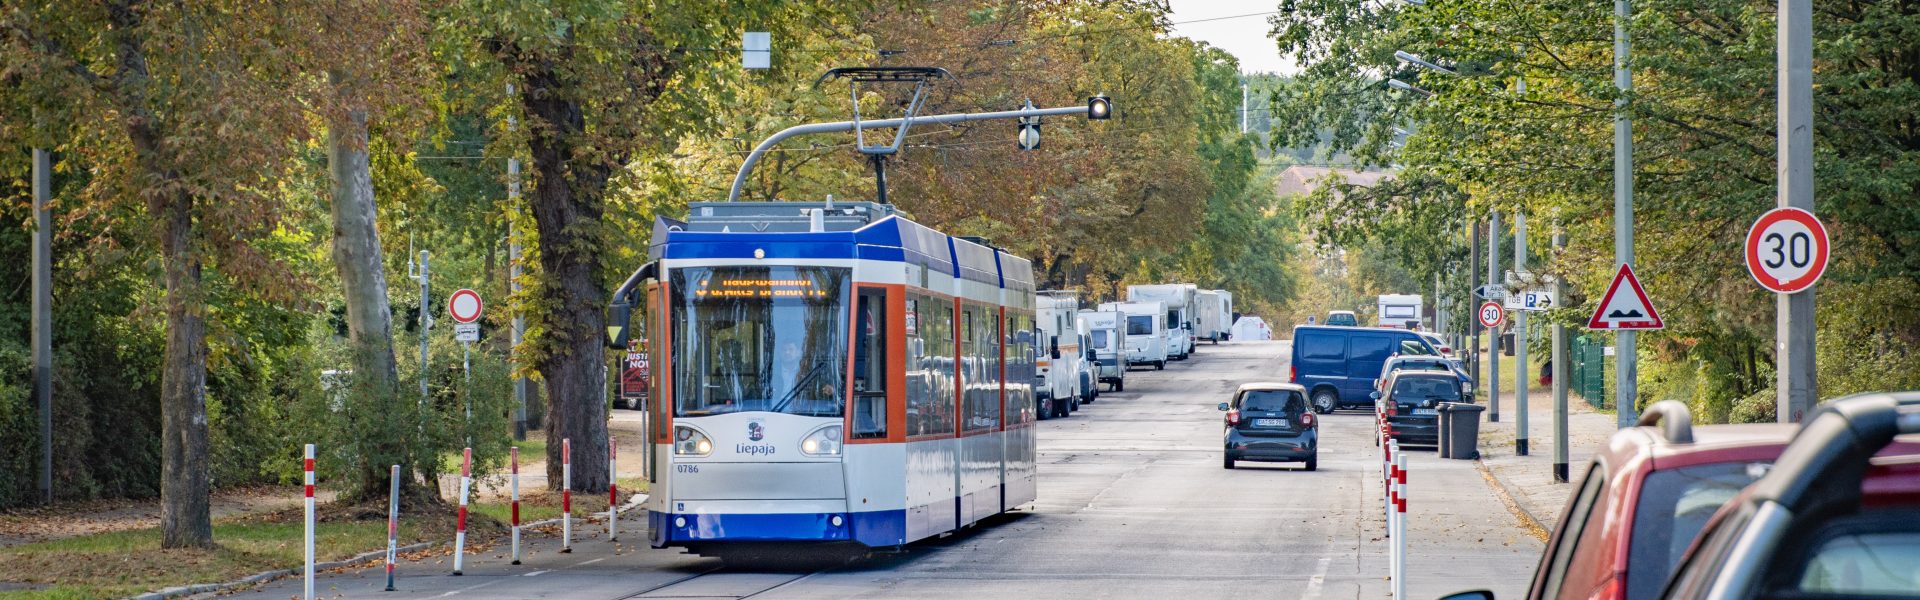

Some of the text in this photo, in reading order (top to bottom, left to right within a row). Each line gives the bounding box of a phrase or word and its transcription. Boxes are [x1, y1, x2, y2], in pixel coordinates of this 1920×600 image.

[1764, 232, 1811, 269] 30
[1484, 309, 1498, 321] 30
[735, 443, 776, 457] Liepaja
[677, 464, 699, 474] 0786
